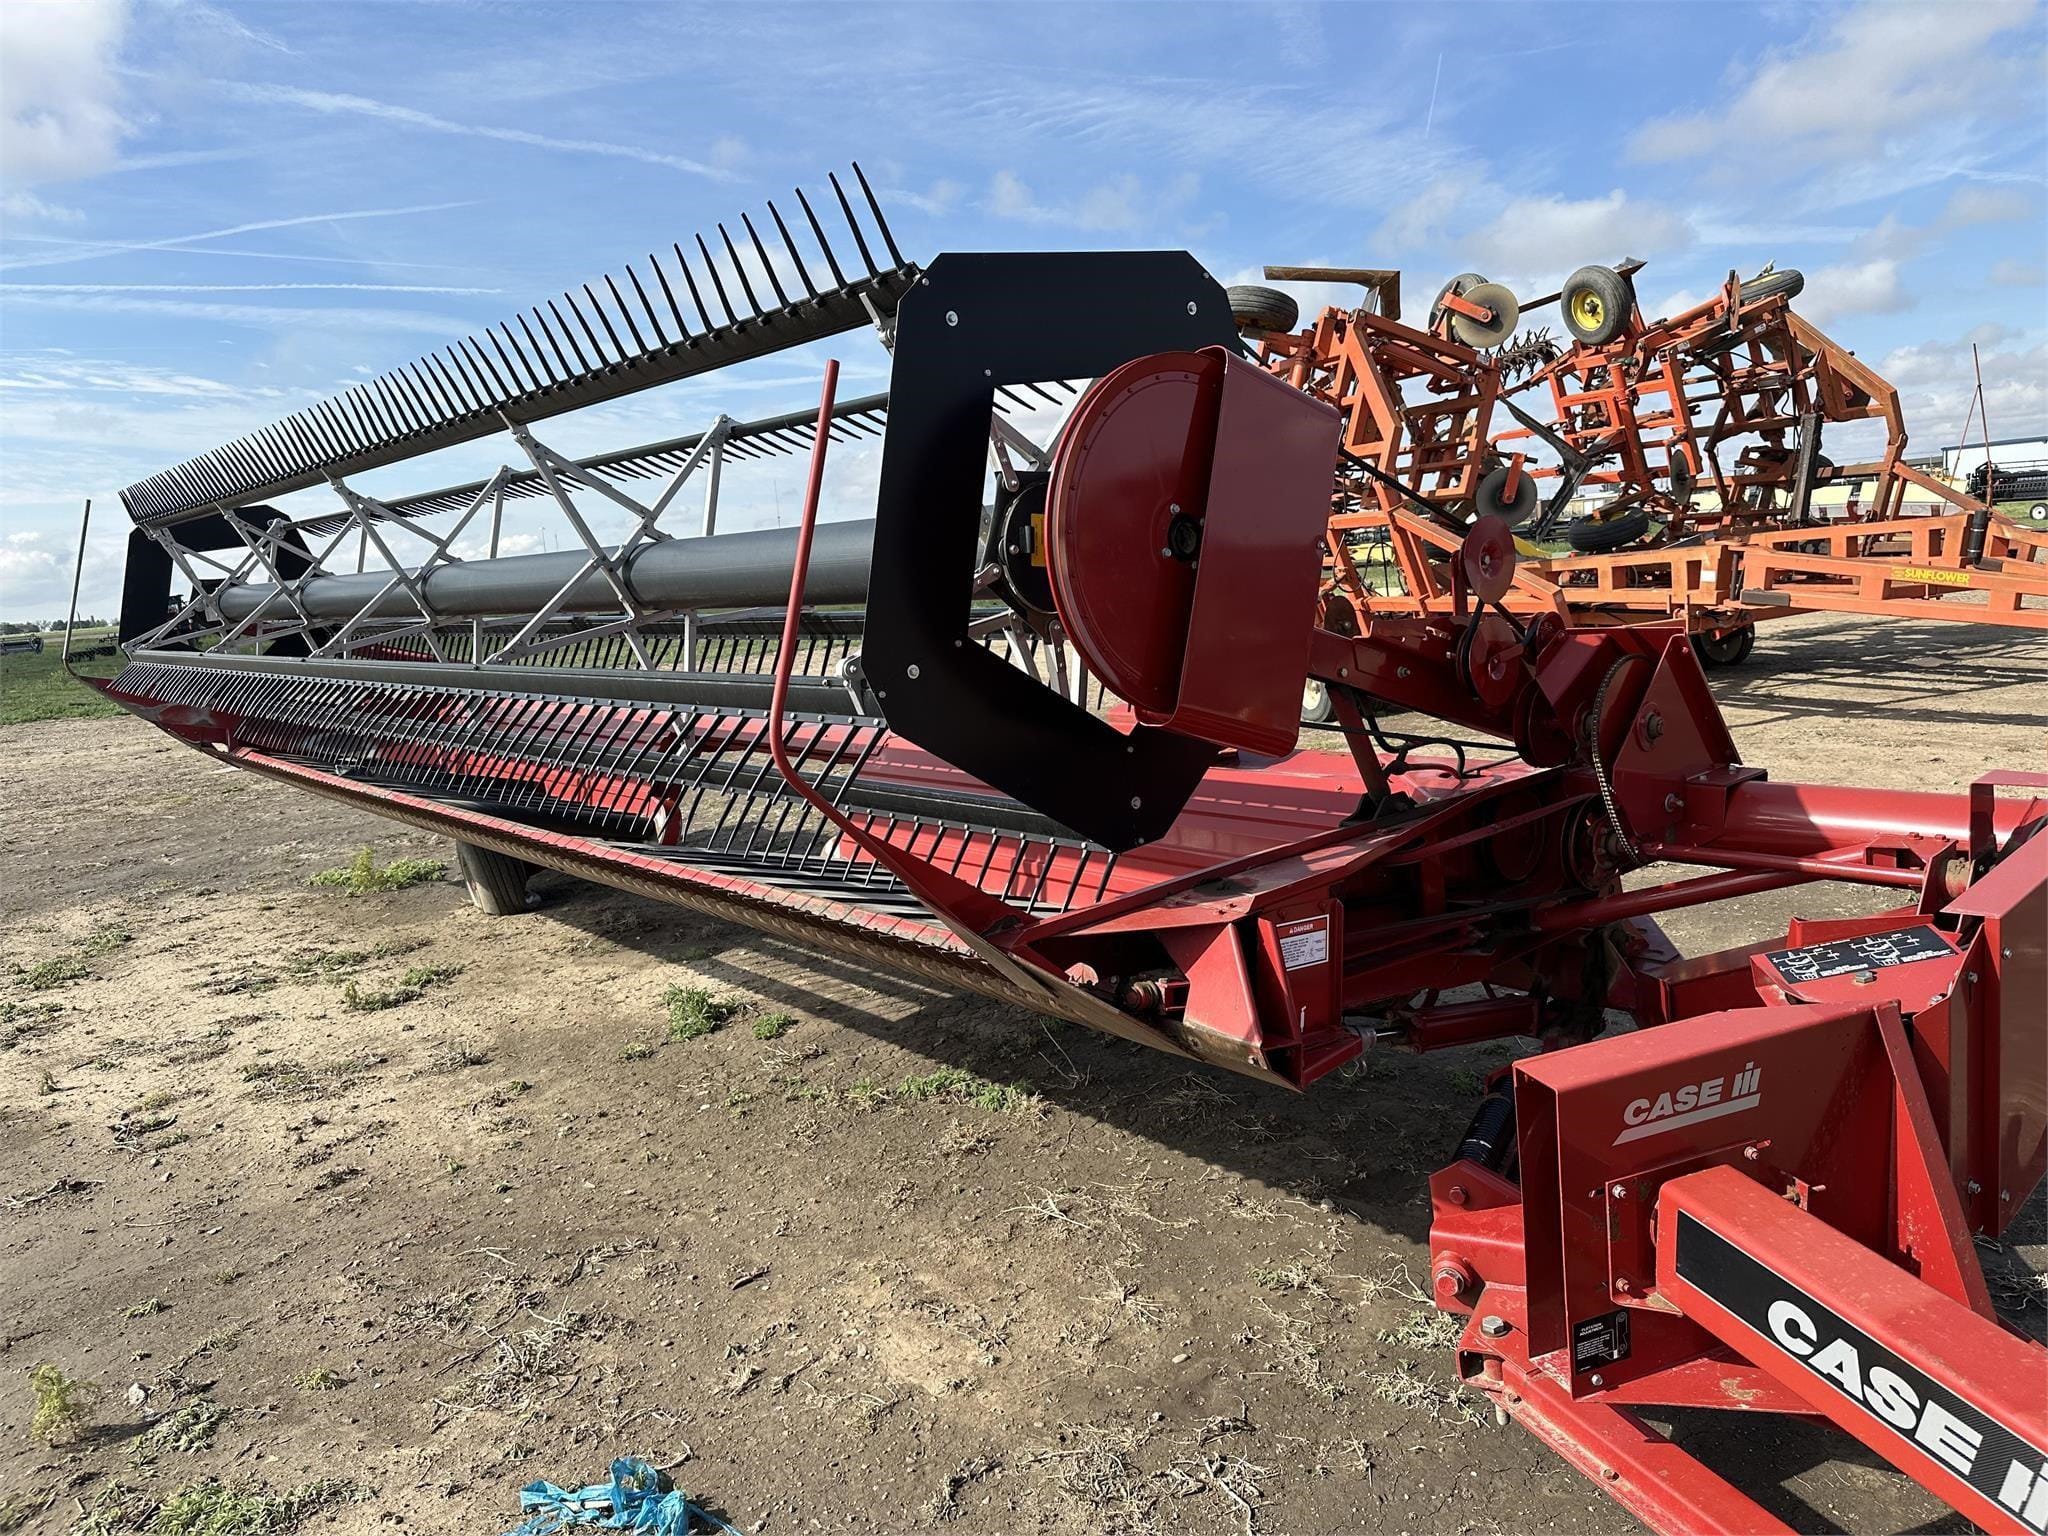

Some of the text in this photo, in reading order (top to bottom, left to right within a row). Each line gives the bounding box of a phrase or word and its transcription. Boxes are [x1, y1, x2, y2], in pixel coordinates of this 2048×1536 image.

[1904, 568, 1970, 583] SUNFLOWER
[1293, 923, 1313, 933] DANGER
[1623, 1077, 1724, 1126] CASE
[1767, 1300, 1983, 1476] CASE
